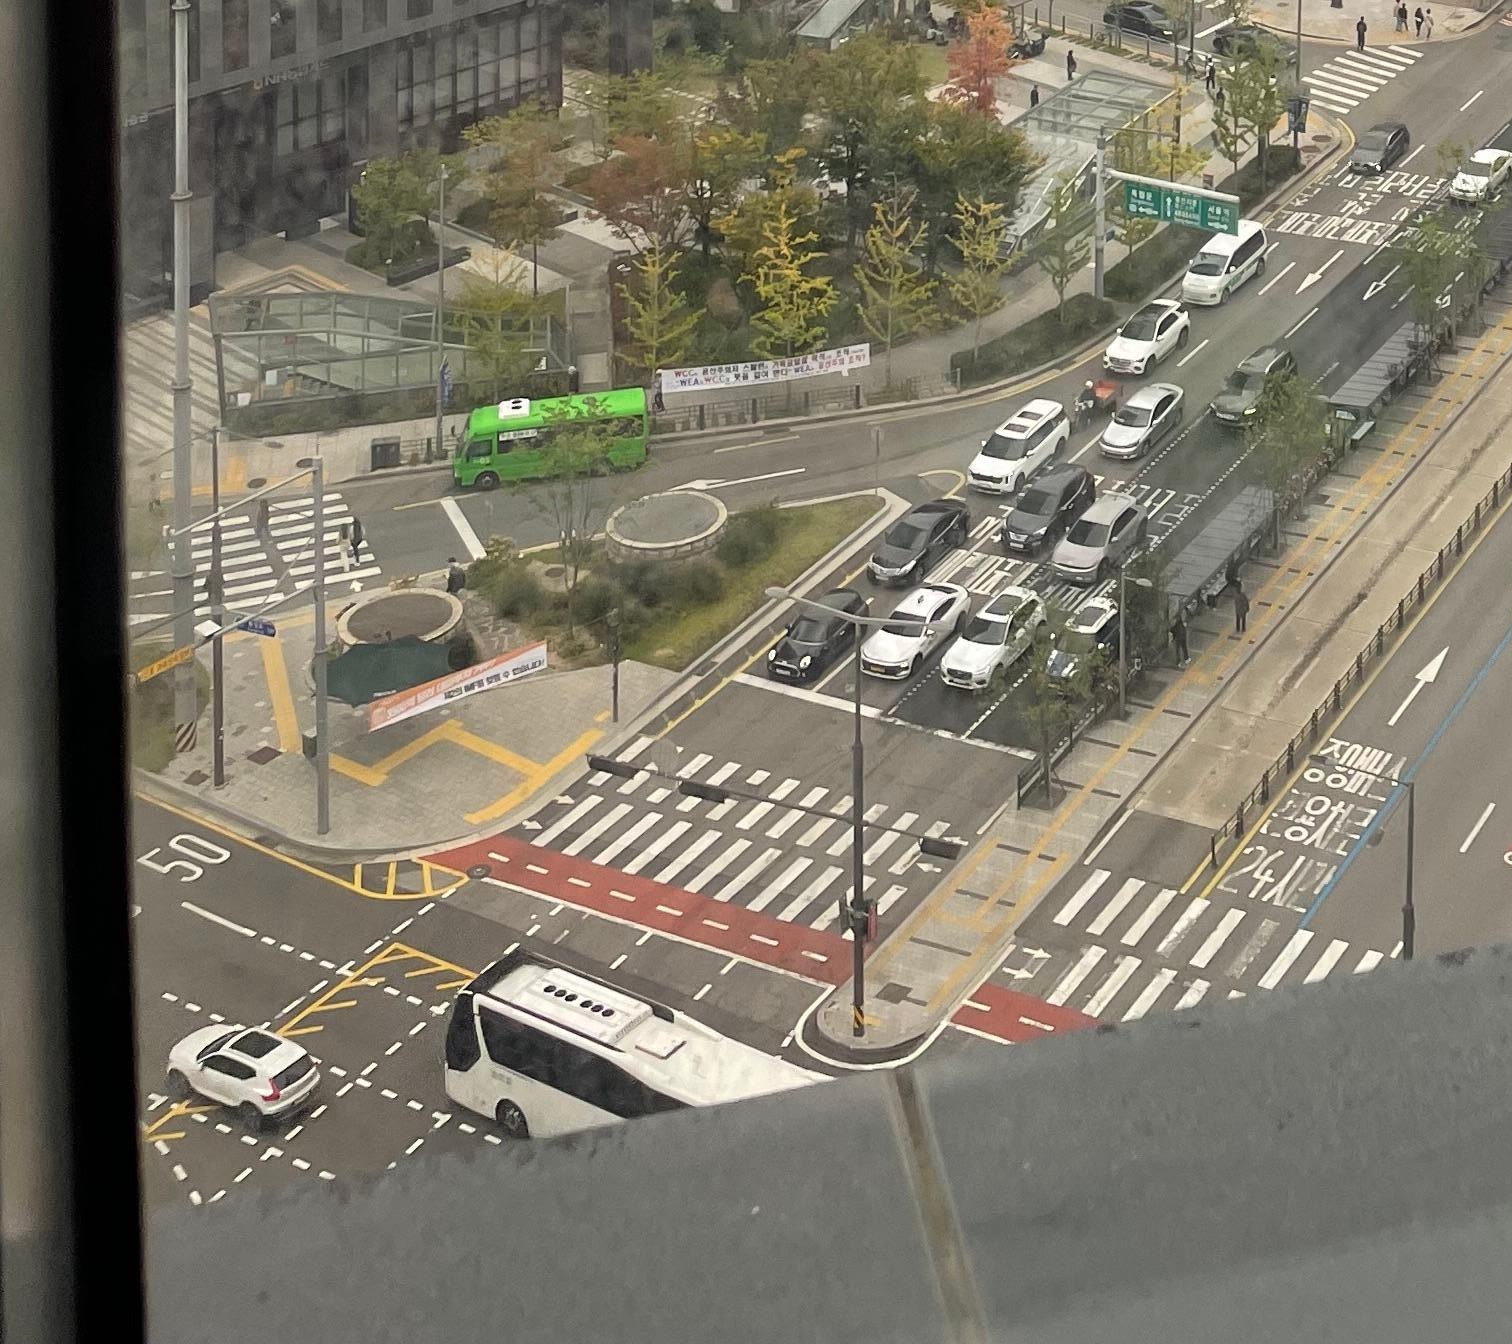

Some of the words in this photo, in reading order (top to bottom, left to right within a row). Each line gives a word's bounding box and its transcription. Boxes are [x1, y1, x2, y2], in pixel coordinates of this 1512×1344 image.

[1303, 737, 1408, 802] 중앙버스
[136, 833, 231, 883] 50
[1219, 846, 1339, 913] 24시간
